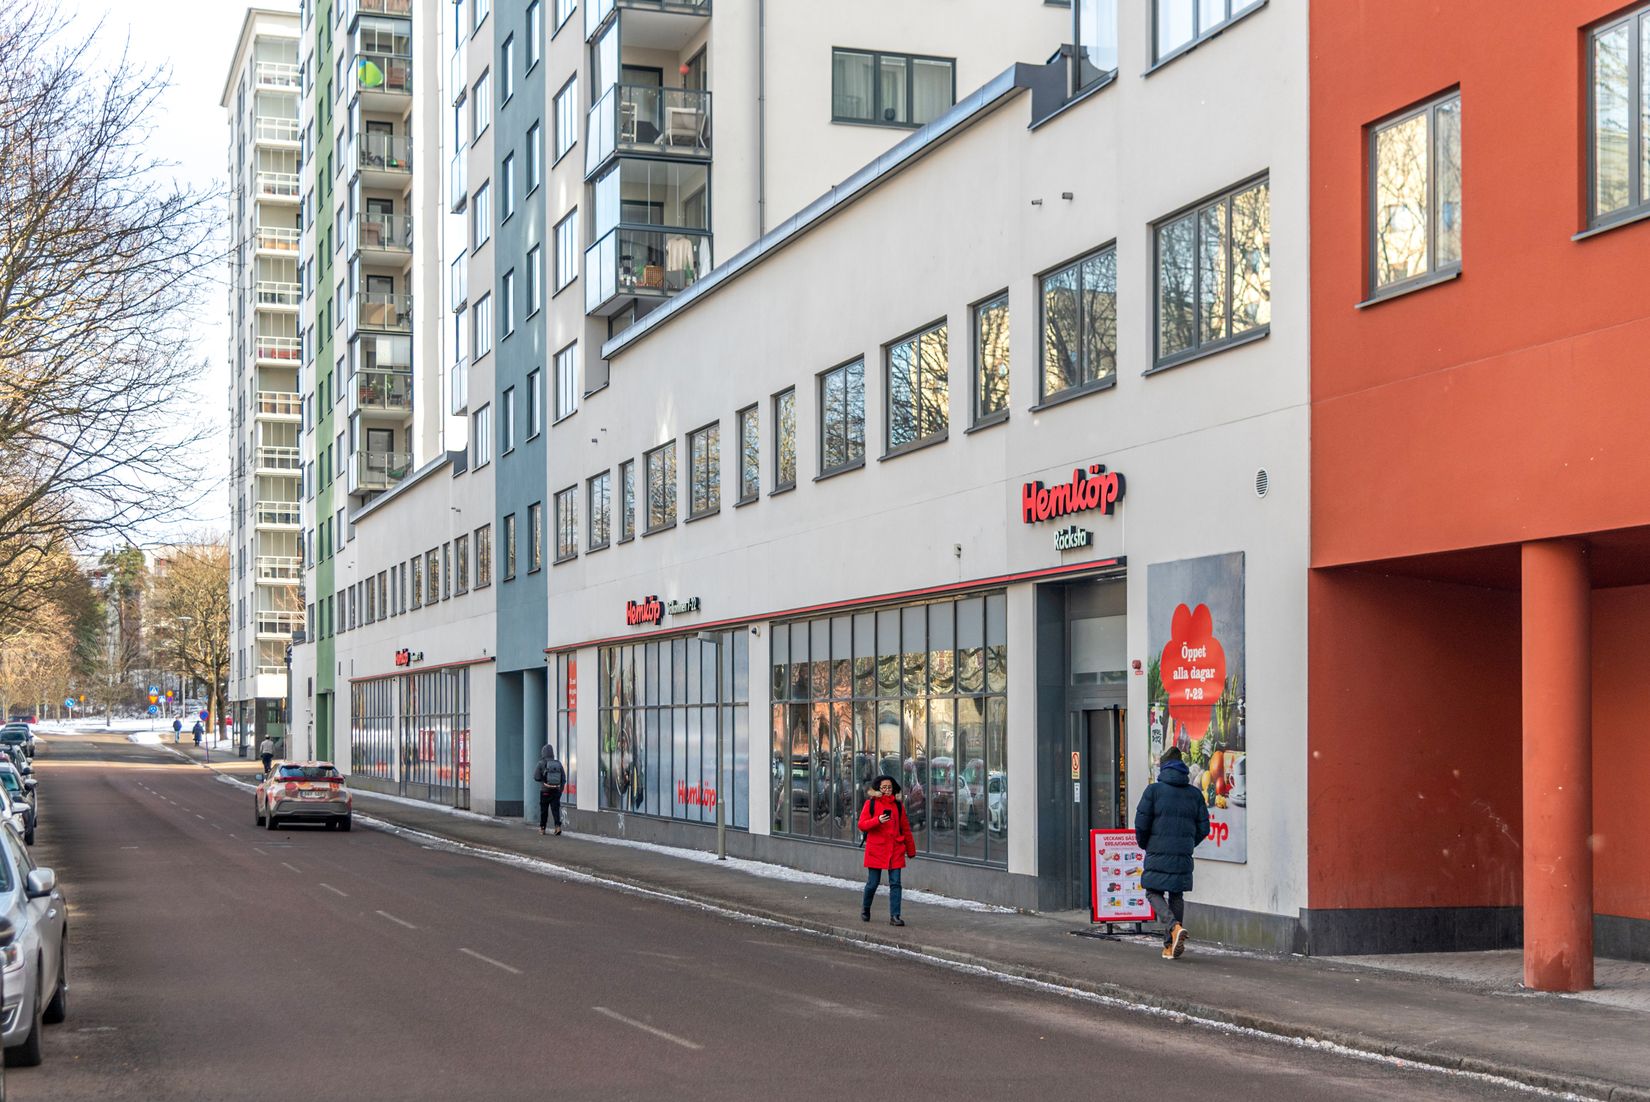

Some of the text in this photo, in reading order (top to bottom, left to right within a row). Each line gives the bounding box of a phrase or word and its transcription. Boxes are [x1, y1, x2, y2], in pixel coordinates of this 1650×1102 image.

[1022, 464, 1121, 523] Hemköp
[627, 595, 662, 625] Hemköp
[1181, 642, 1207, 662] Öppet
[1173, 666, 1215, 682] alla dagar
